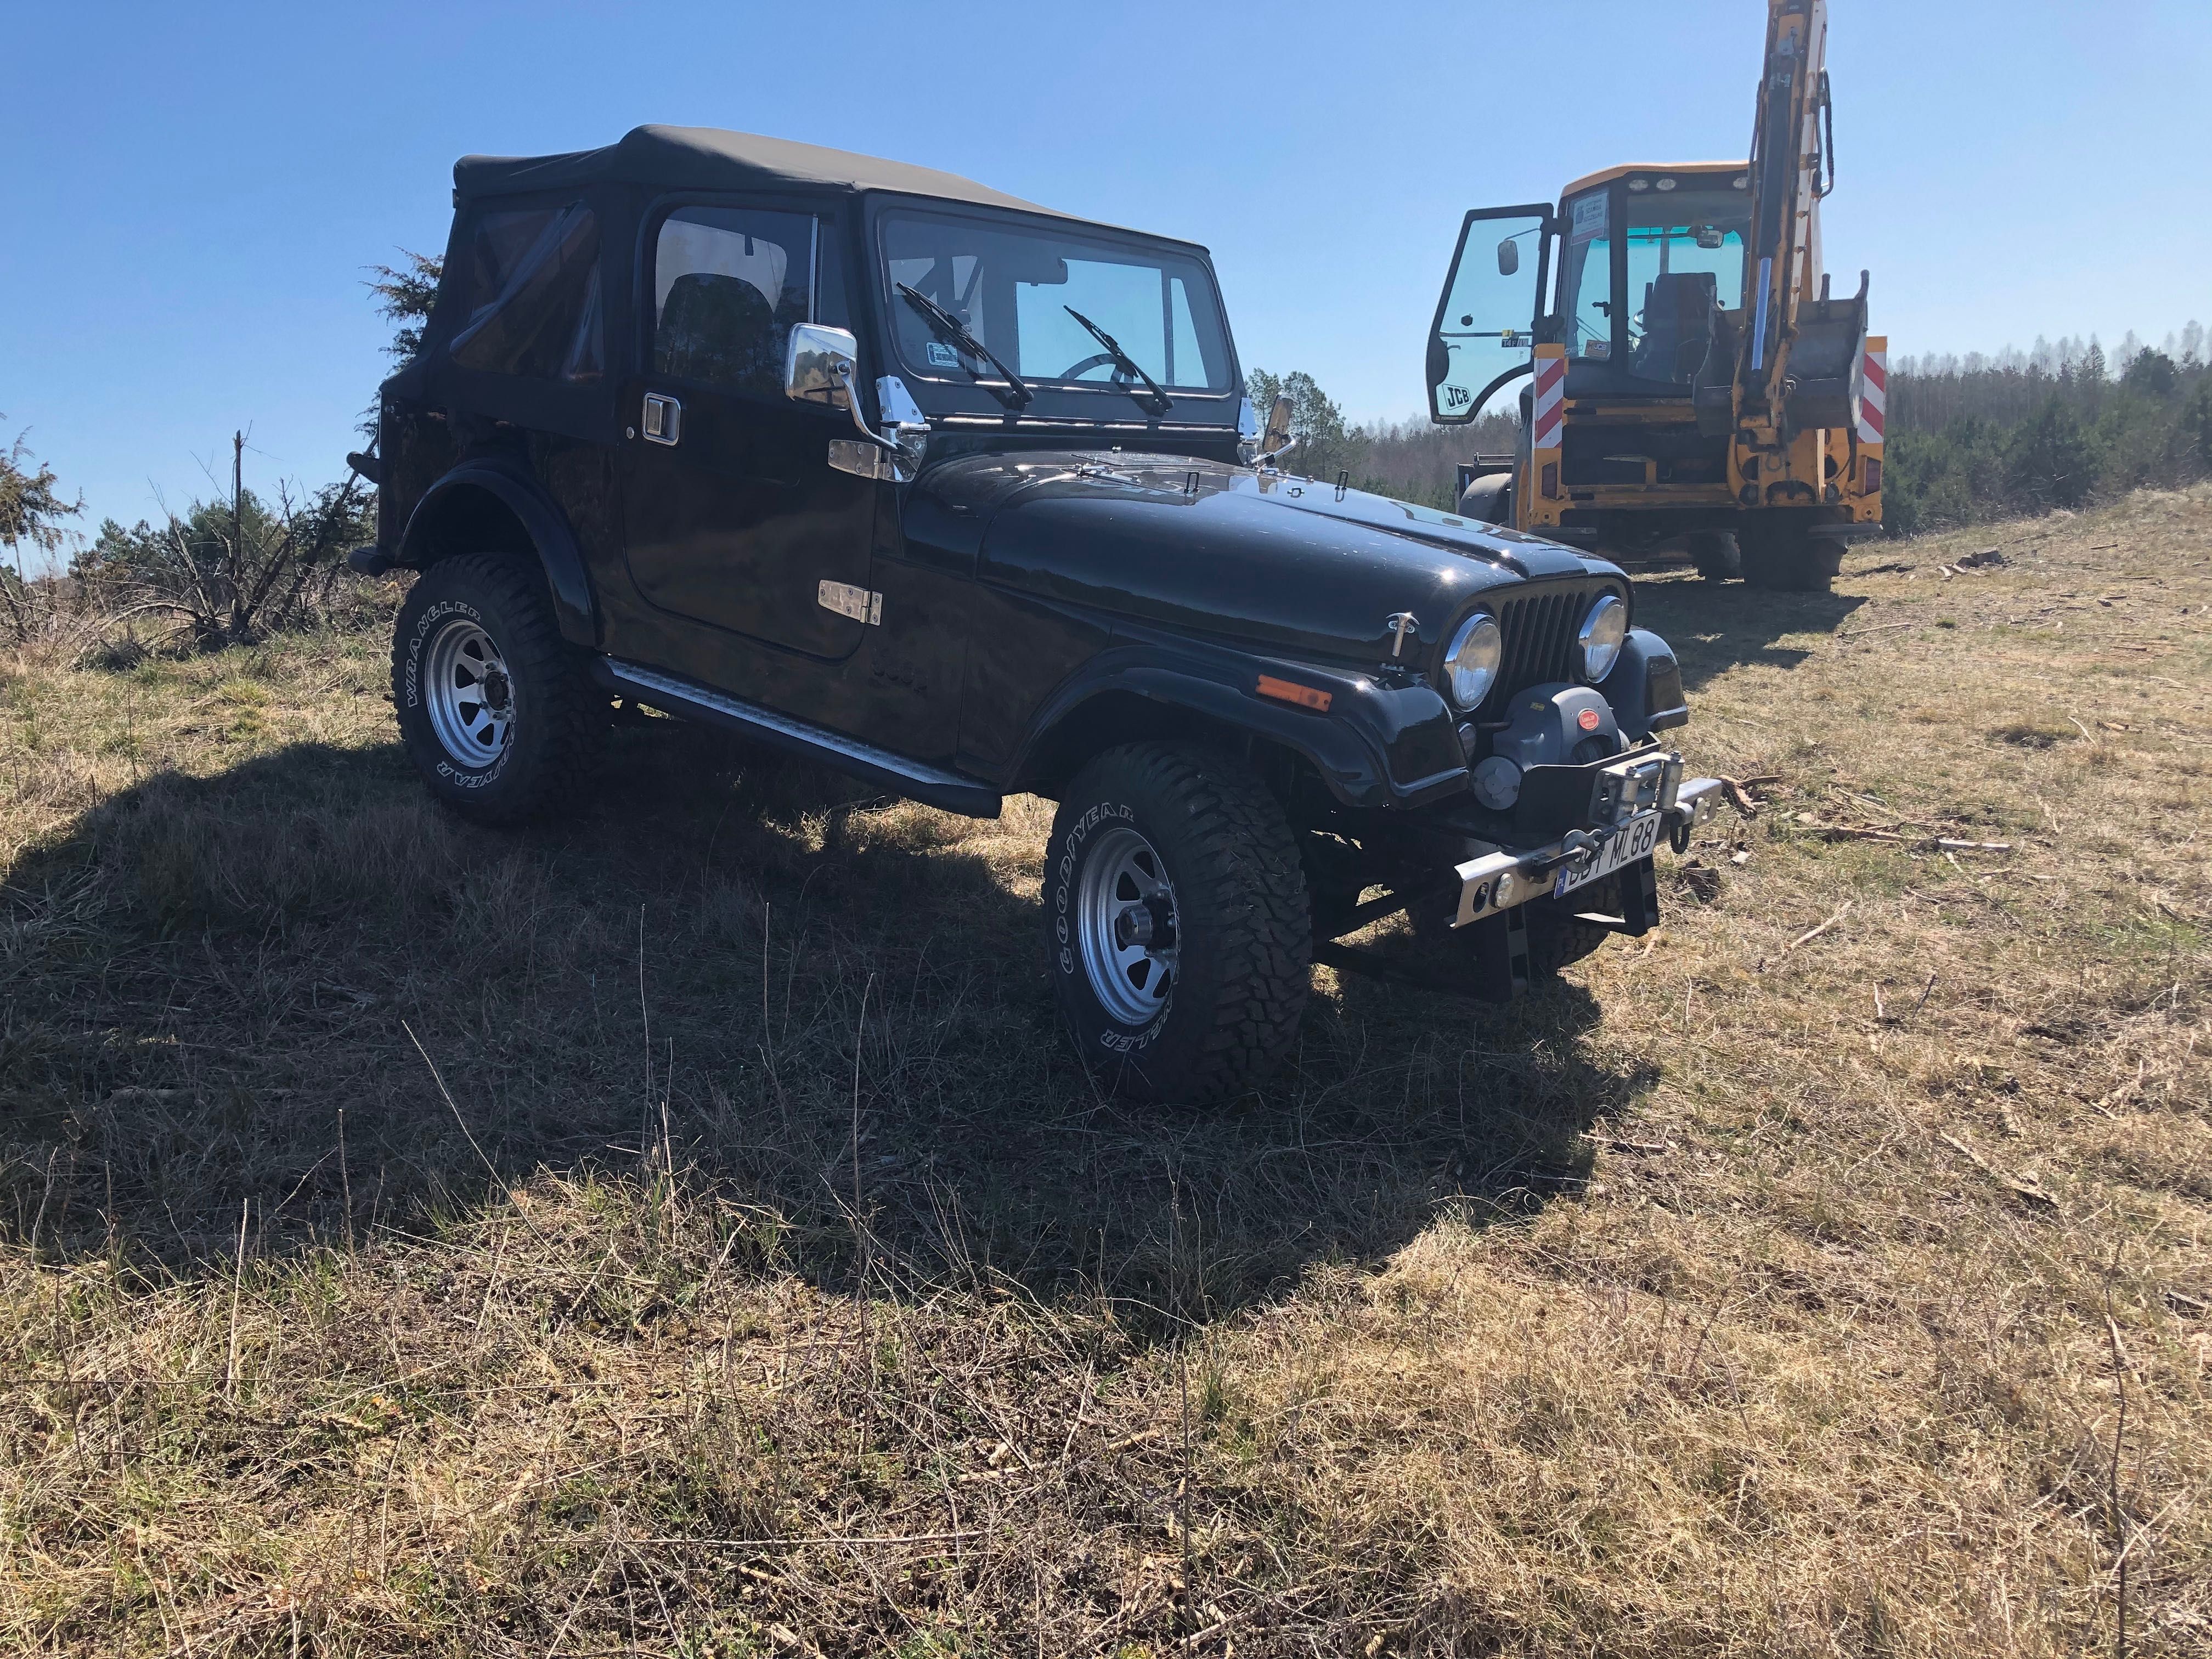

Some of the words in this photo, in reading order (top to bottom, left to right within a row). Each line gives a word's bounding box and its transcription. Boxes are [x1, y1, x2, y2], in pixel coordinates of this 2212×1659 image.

[1447, 387, 1469, 407] JCB
[405, 601, 481, 708] WRANGLER
[1609, 819, 1655, 868] ML88
[1056, 802, 1134, 974] GOODYEAR
